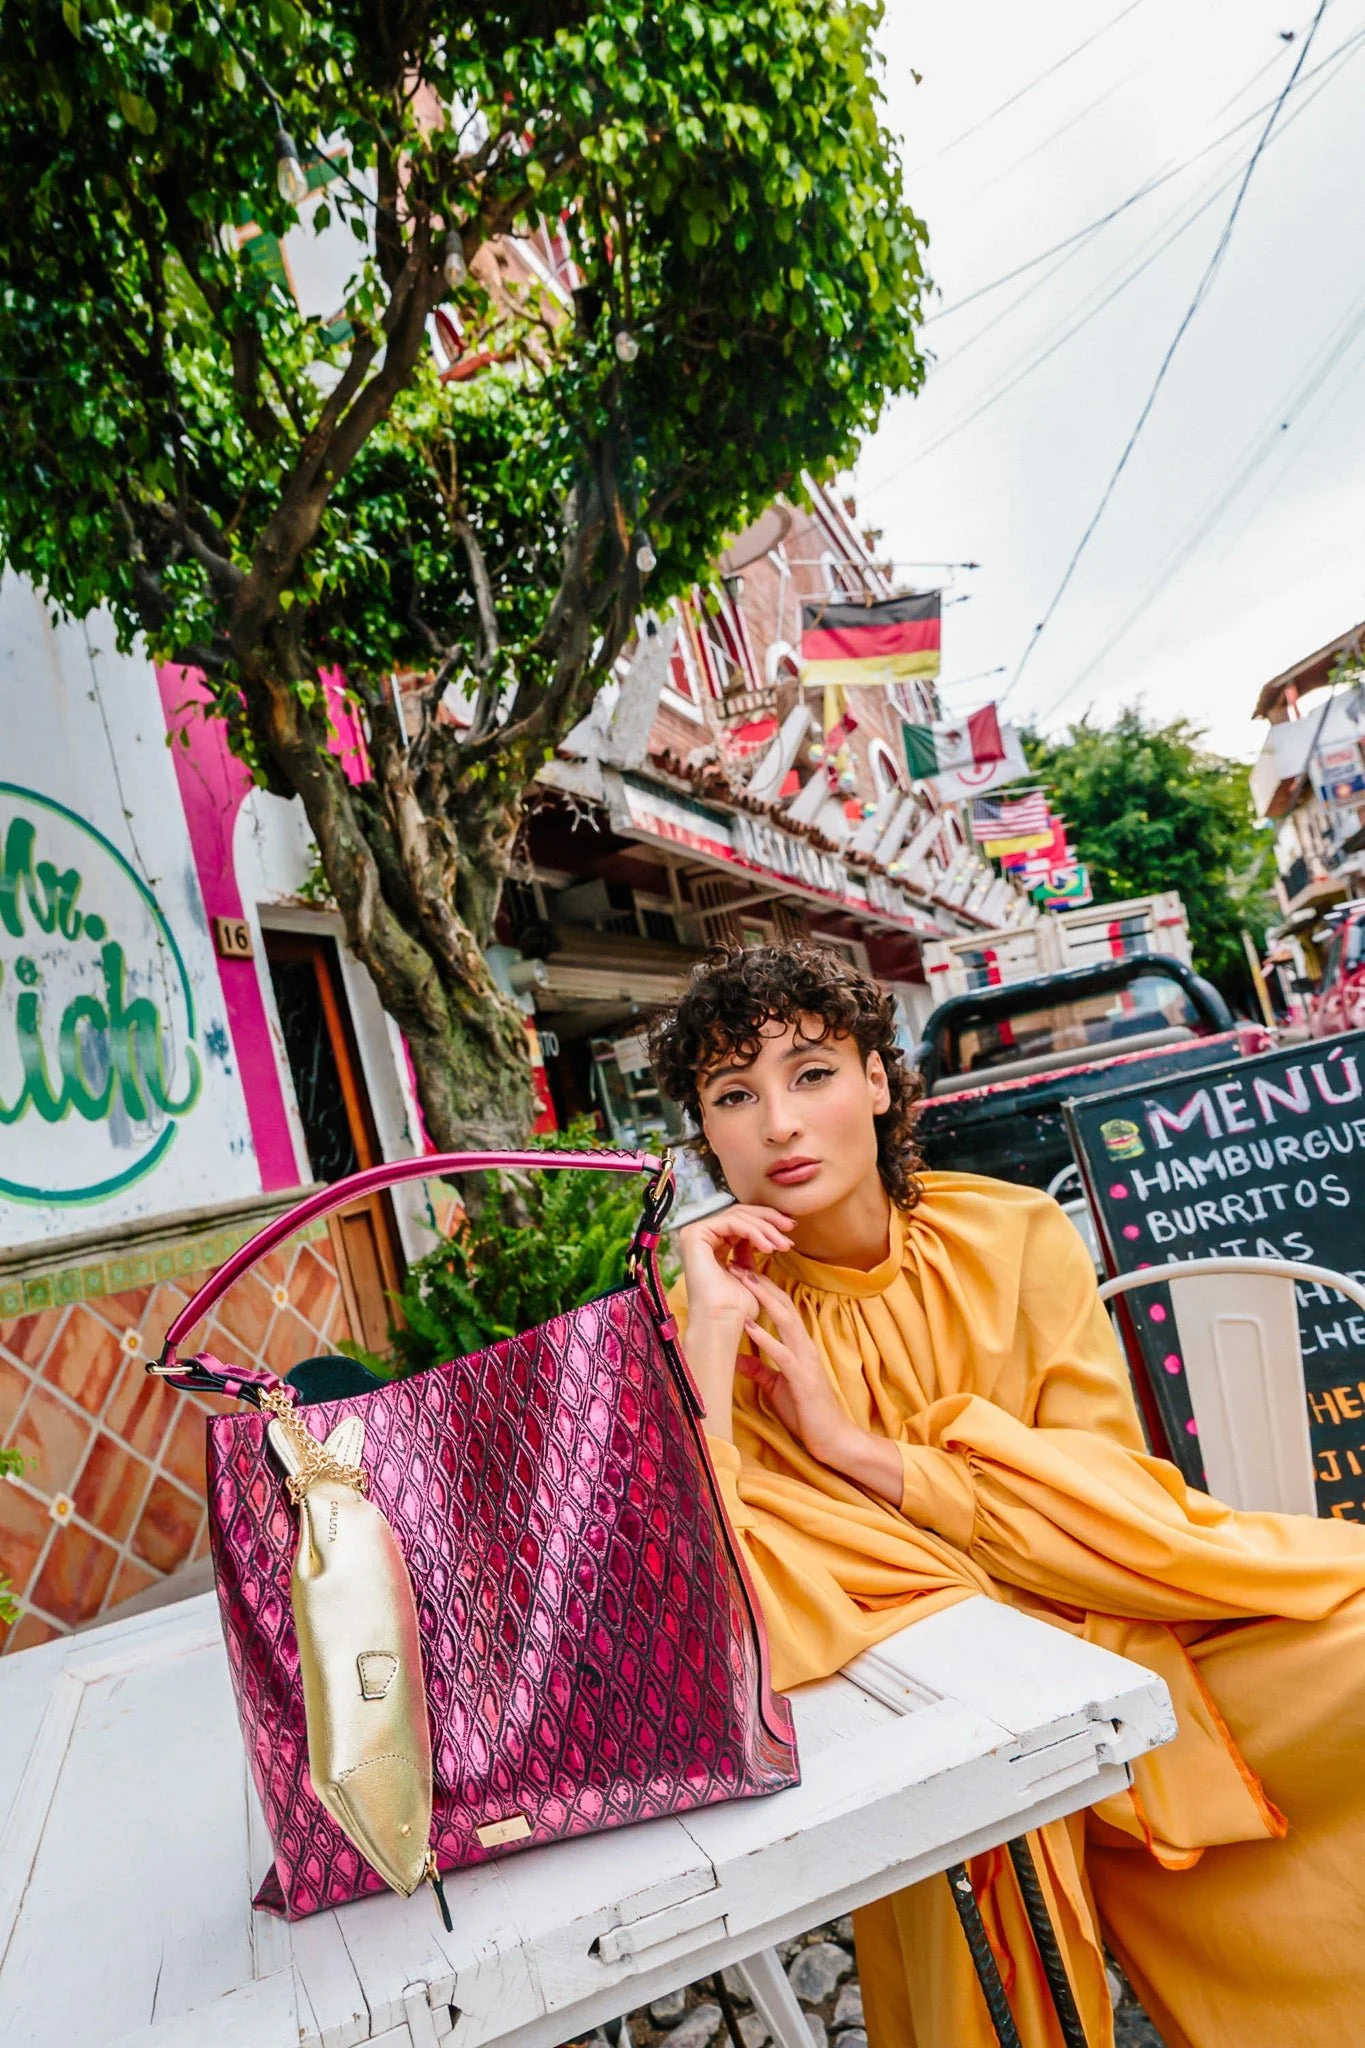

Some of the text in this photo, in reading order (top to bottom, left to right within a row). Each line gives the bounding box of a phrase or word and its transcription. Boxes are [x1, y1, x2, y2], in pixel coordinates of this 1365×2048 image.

[224, 925, 248, 950] 16
[1144, 1046, 1363, 1149] MENÚ
[1146, 1174, 1351, 1243] BURRITOS
[328, 1500, 339, 1543] CARLOTA
